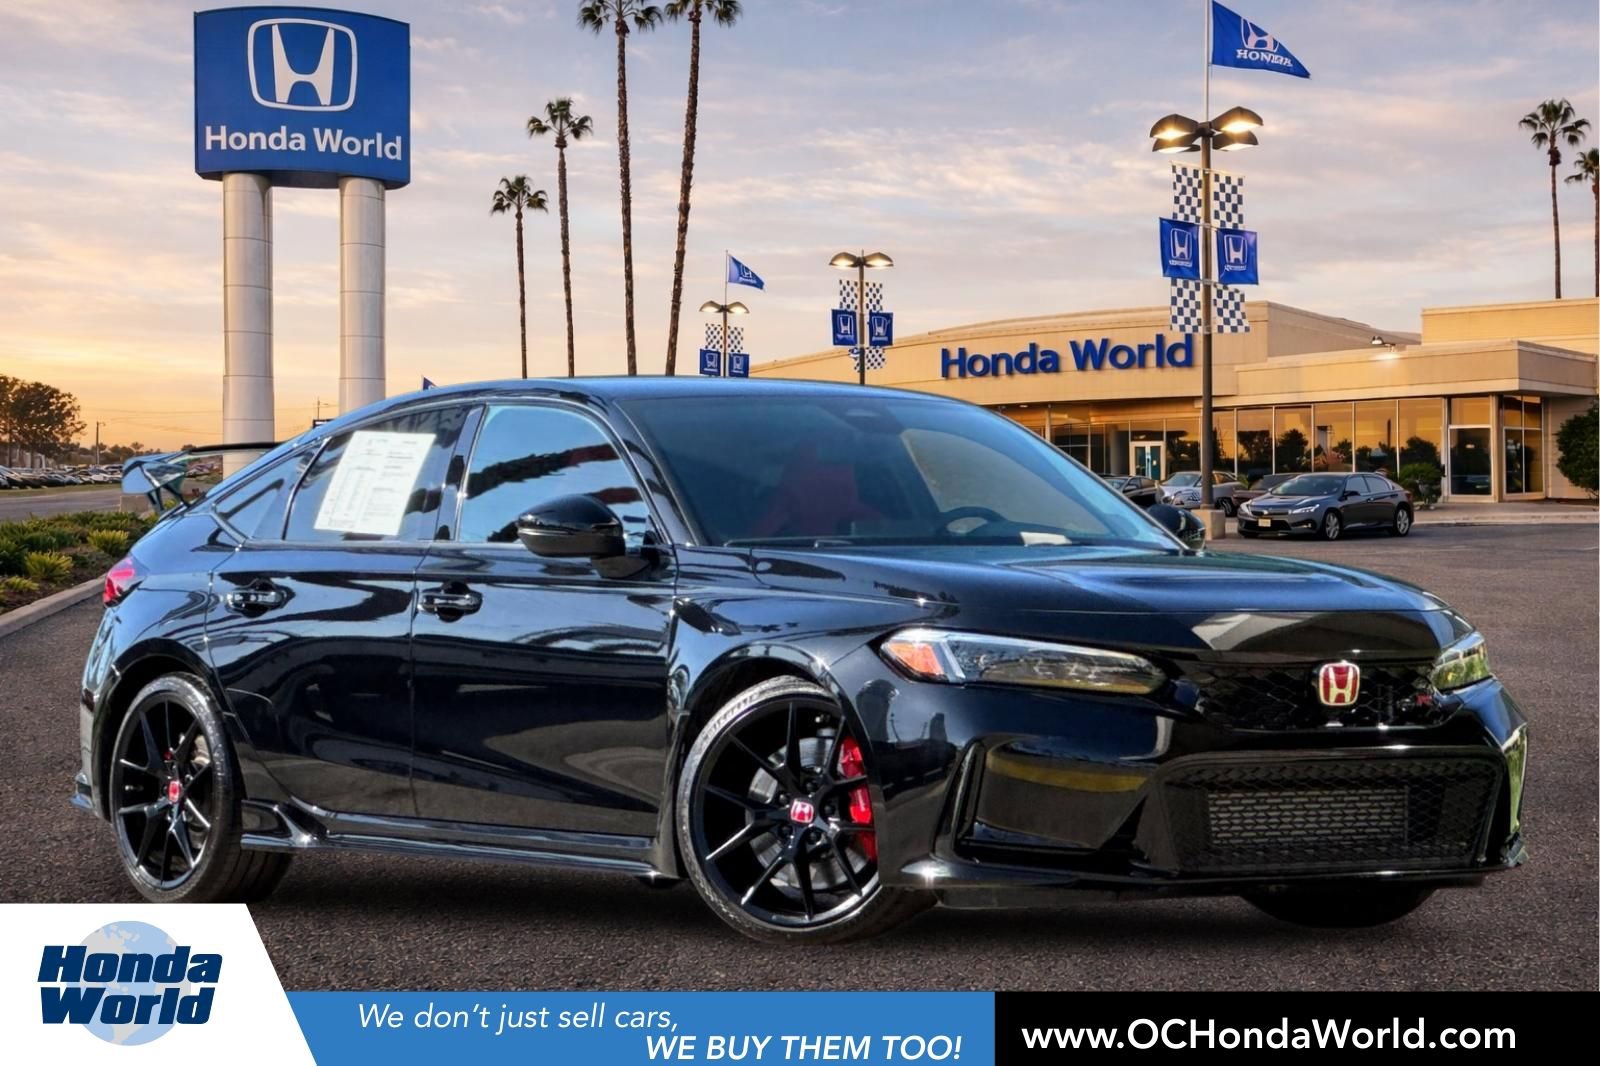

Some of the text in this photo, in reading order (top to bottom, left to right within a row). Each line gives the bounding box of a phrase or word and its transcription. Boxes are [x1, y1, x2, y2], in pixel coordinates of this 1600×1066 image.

[205, 125, 402, 161] Honda World
[941, 333, 1195, 378] Honda World
